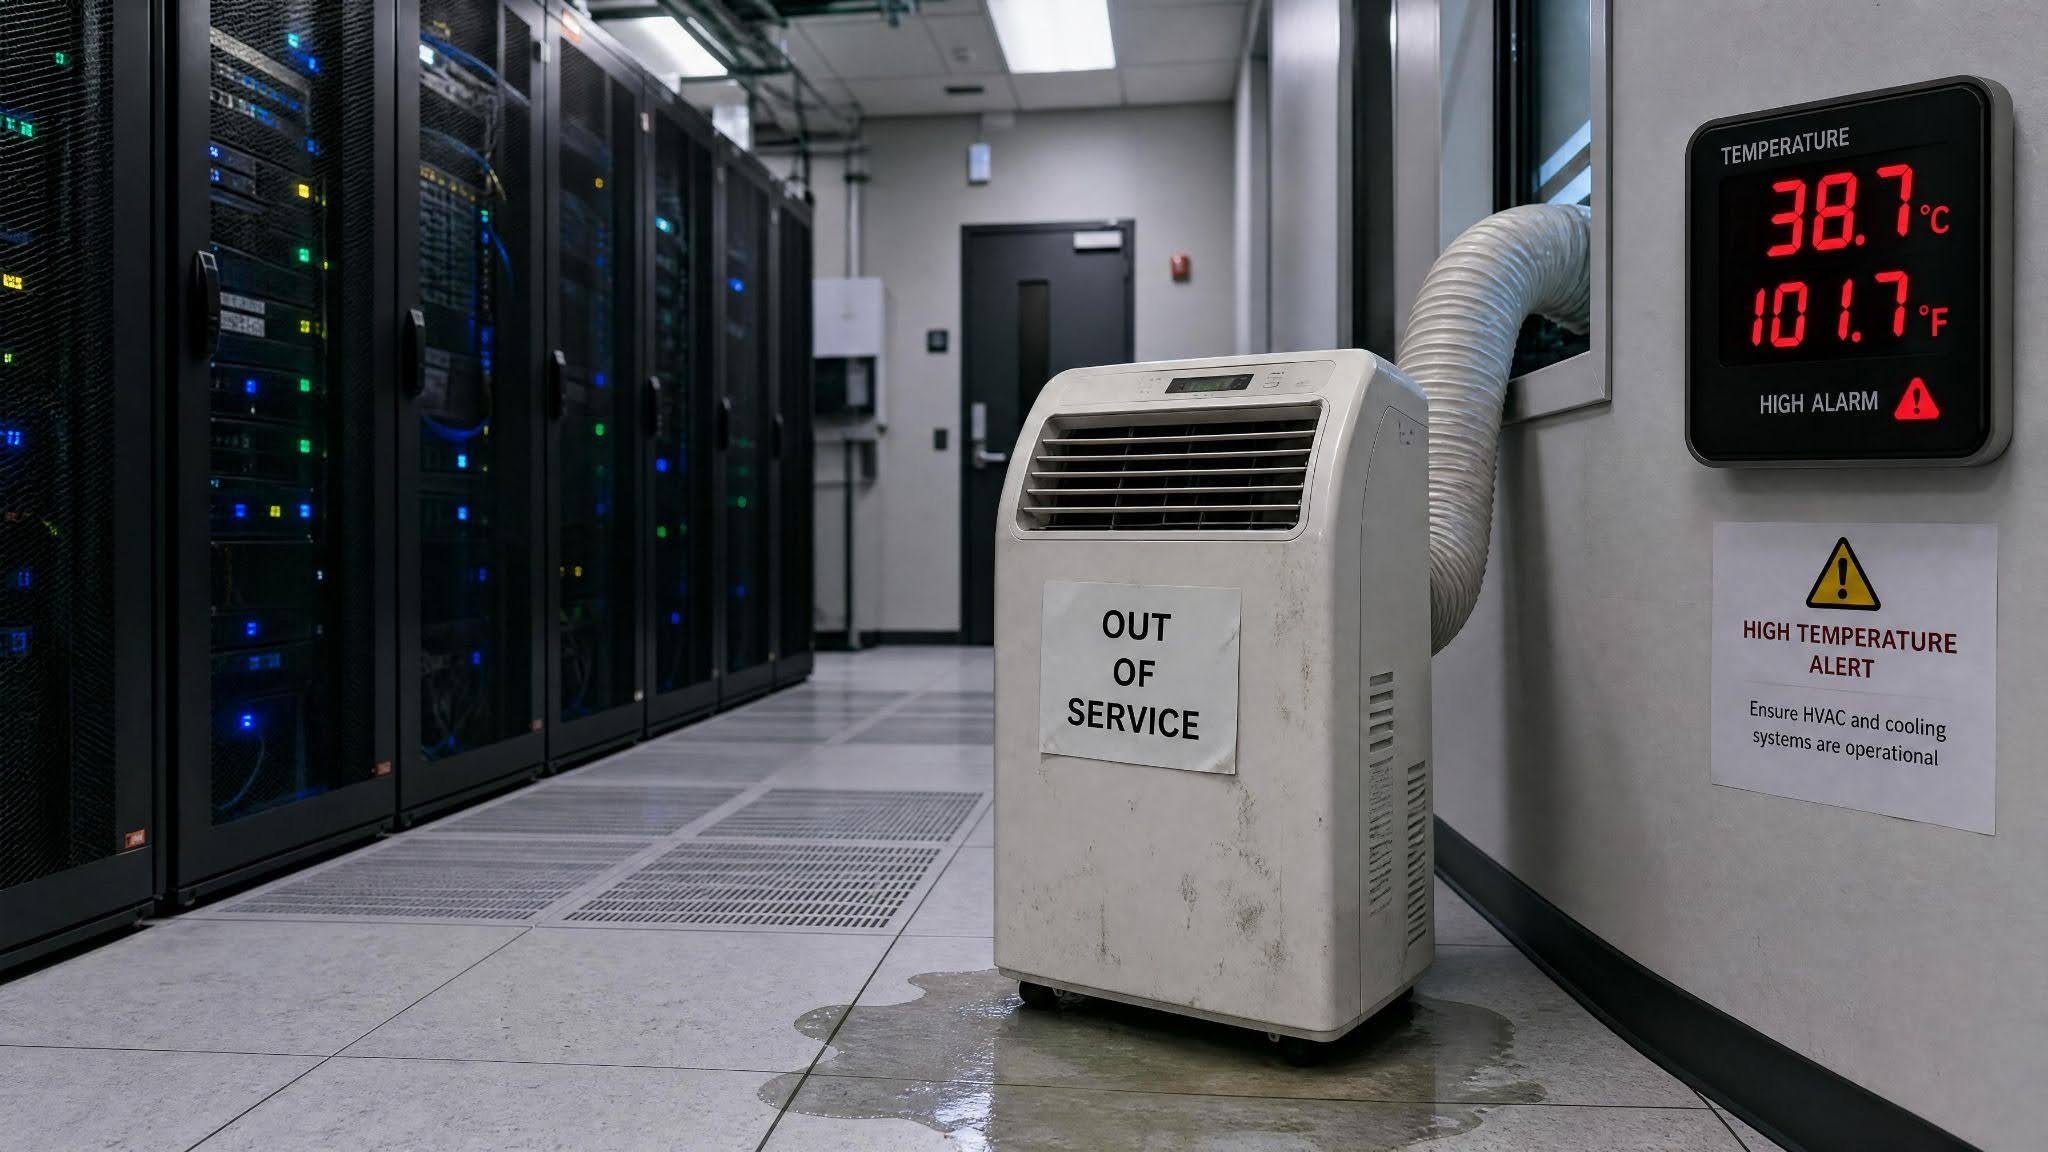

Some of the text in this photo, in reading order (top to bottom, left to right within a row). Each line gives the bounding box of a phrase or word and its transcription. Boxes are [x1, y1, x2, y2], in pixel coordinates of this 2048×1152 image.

[1721, 127, 1850, 165] TEMPERATURE
[1767, 164, 1913, 258] 38.7
[1751, 270, 1908, 347] 101.7
[1760, 390, 1878, 414] HIGH ALARM
[1102, 609, 1172, 642] OUT
[1743, 620, 1957, 654] HIGH TEMPERATURE
[1113, 658, 1156, 687] OF
[1809, 655, 1875, 678] ALERT
[1067, 697, 1200, 741] SERVICE
[1750, 700, 1946, 742] Ensure HVAC and cooling
[1753, 730, 1938, 766] systems are operational
